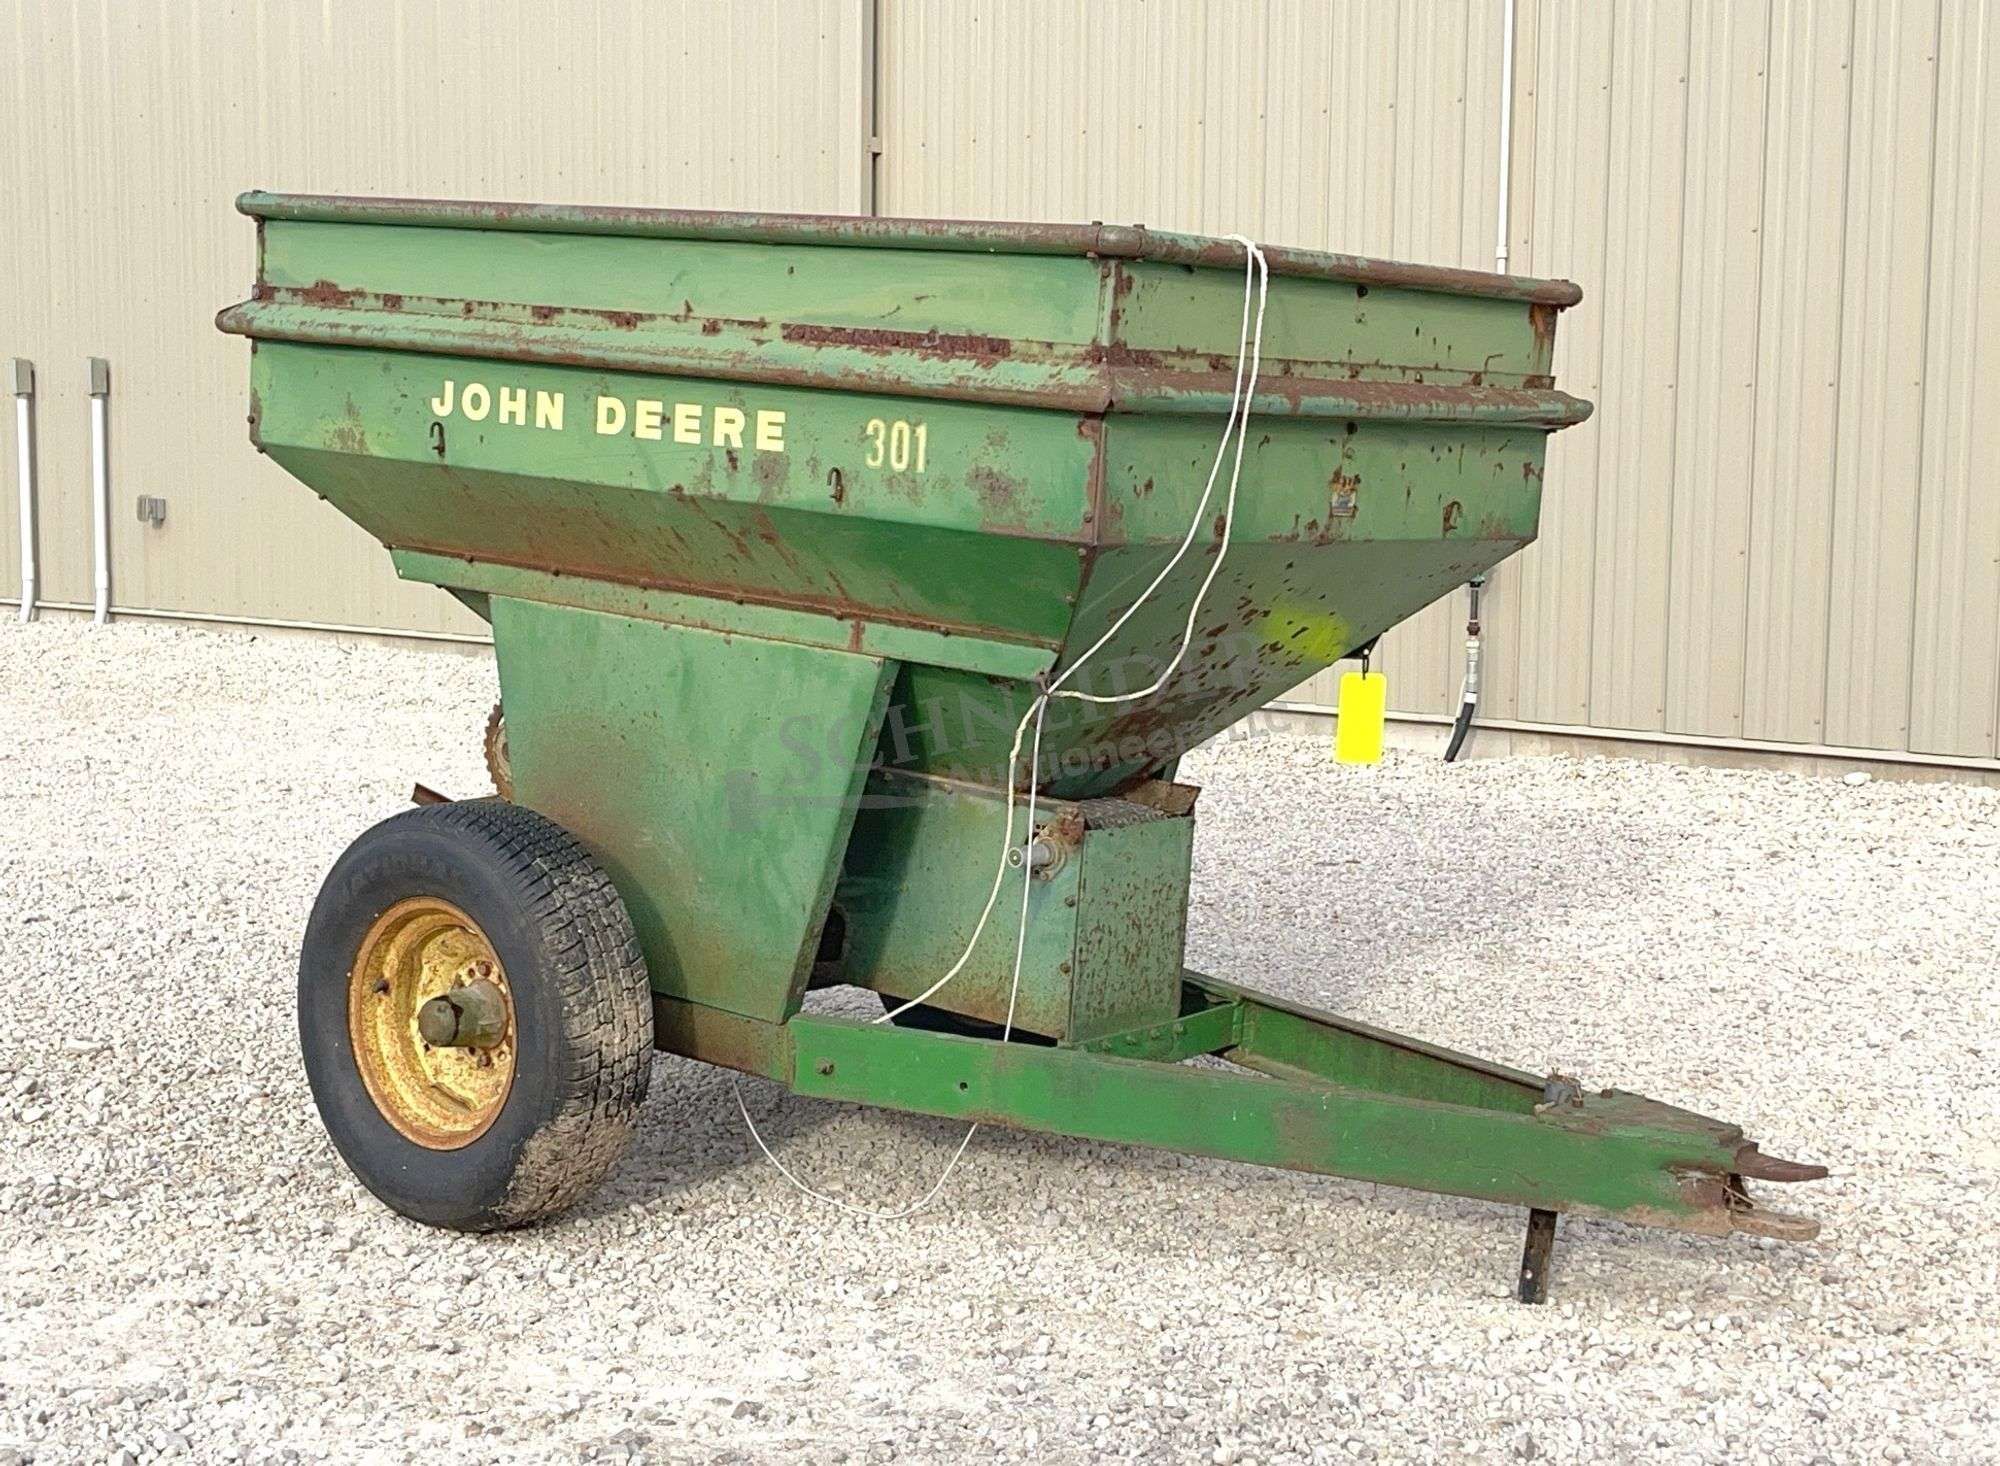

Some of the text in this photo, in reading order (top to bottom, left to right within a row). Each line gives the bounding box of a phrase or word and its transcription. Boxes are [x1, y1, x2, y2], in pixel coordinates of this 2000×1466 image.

[431, 381, 787, 453] JOHN DEERE
[865, 418, 929, 475] 301
